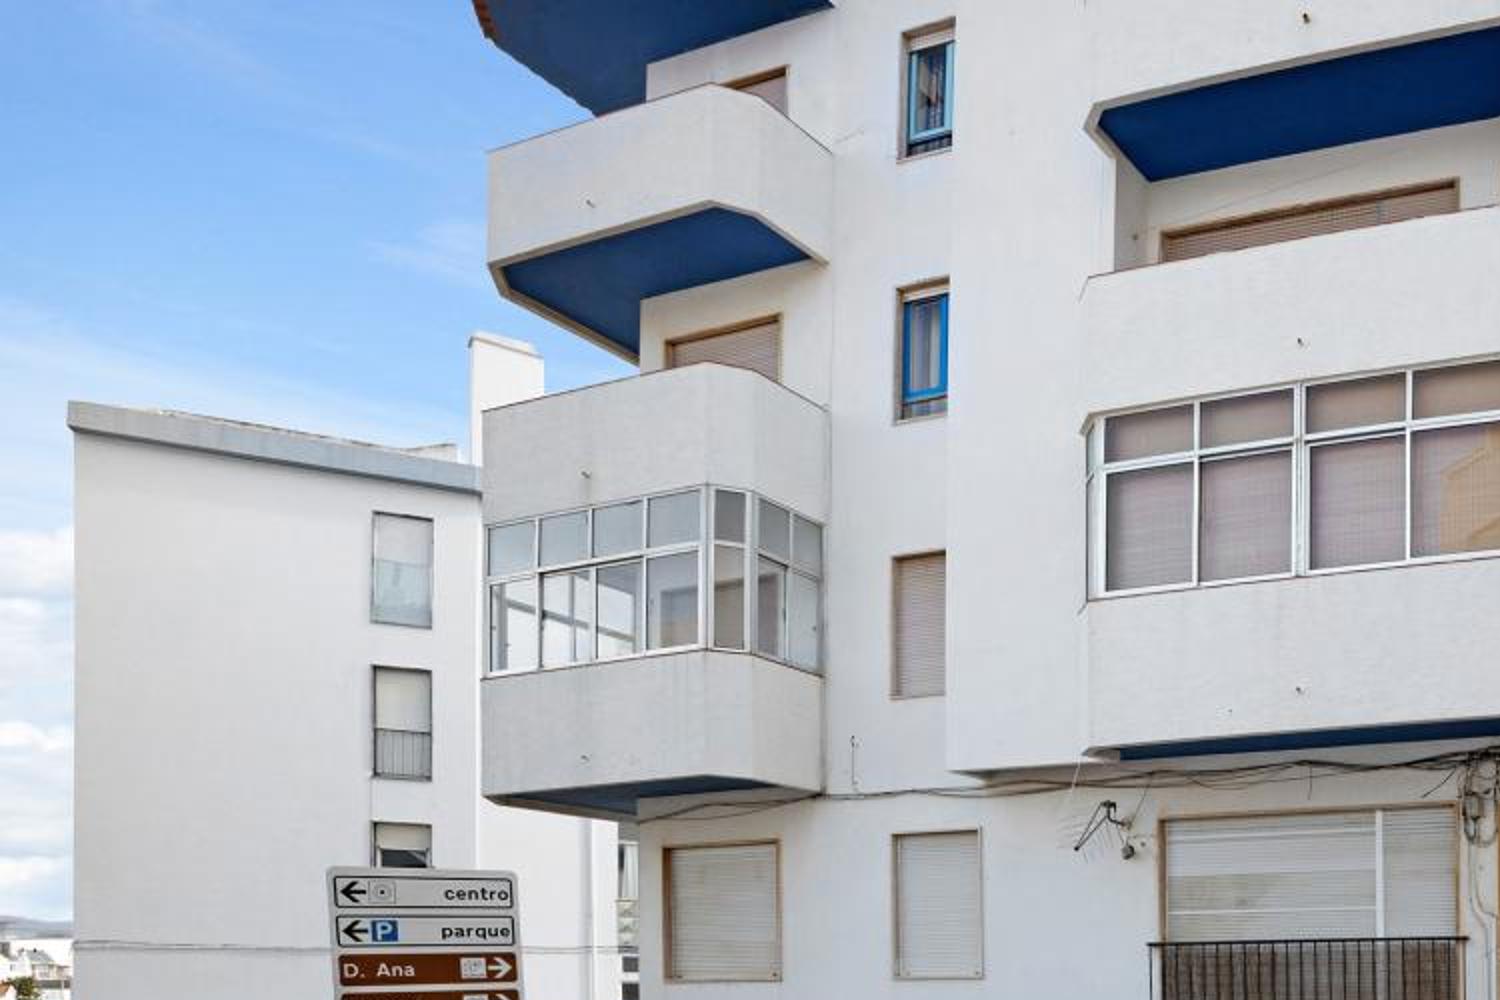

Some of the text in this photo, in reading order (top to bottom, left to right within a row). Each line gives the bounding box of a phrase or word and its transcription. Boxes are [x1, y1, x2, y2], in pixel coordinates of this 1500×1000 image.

[444, 886, 509, 902] centro
[377, 922, 511, 940] P parque
[343, 963, 415, 979] D. Ana
